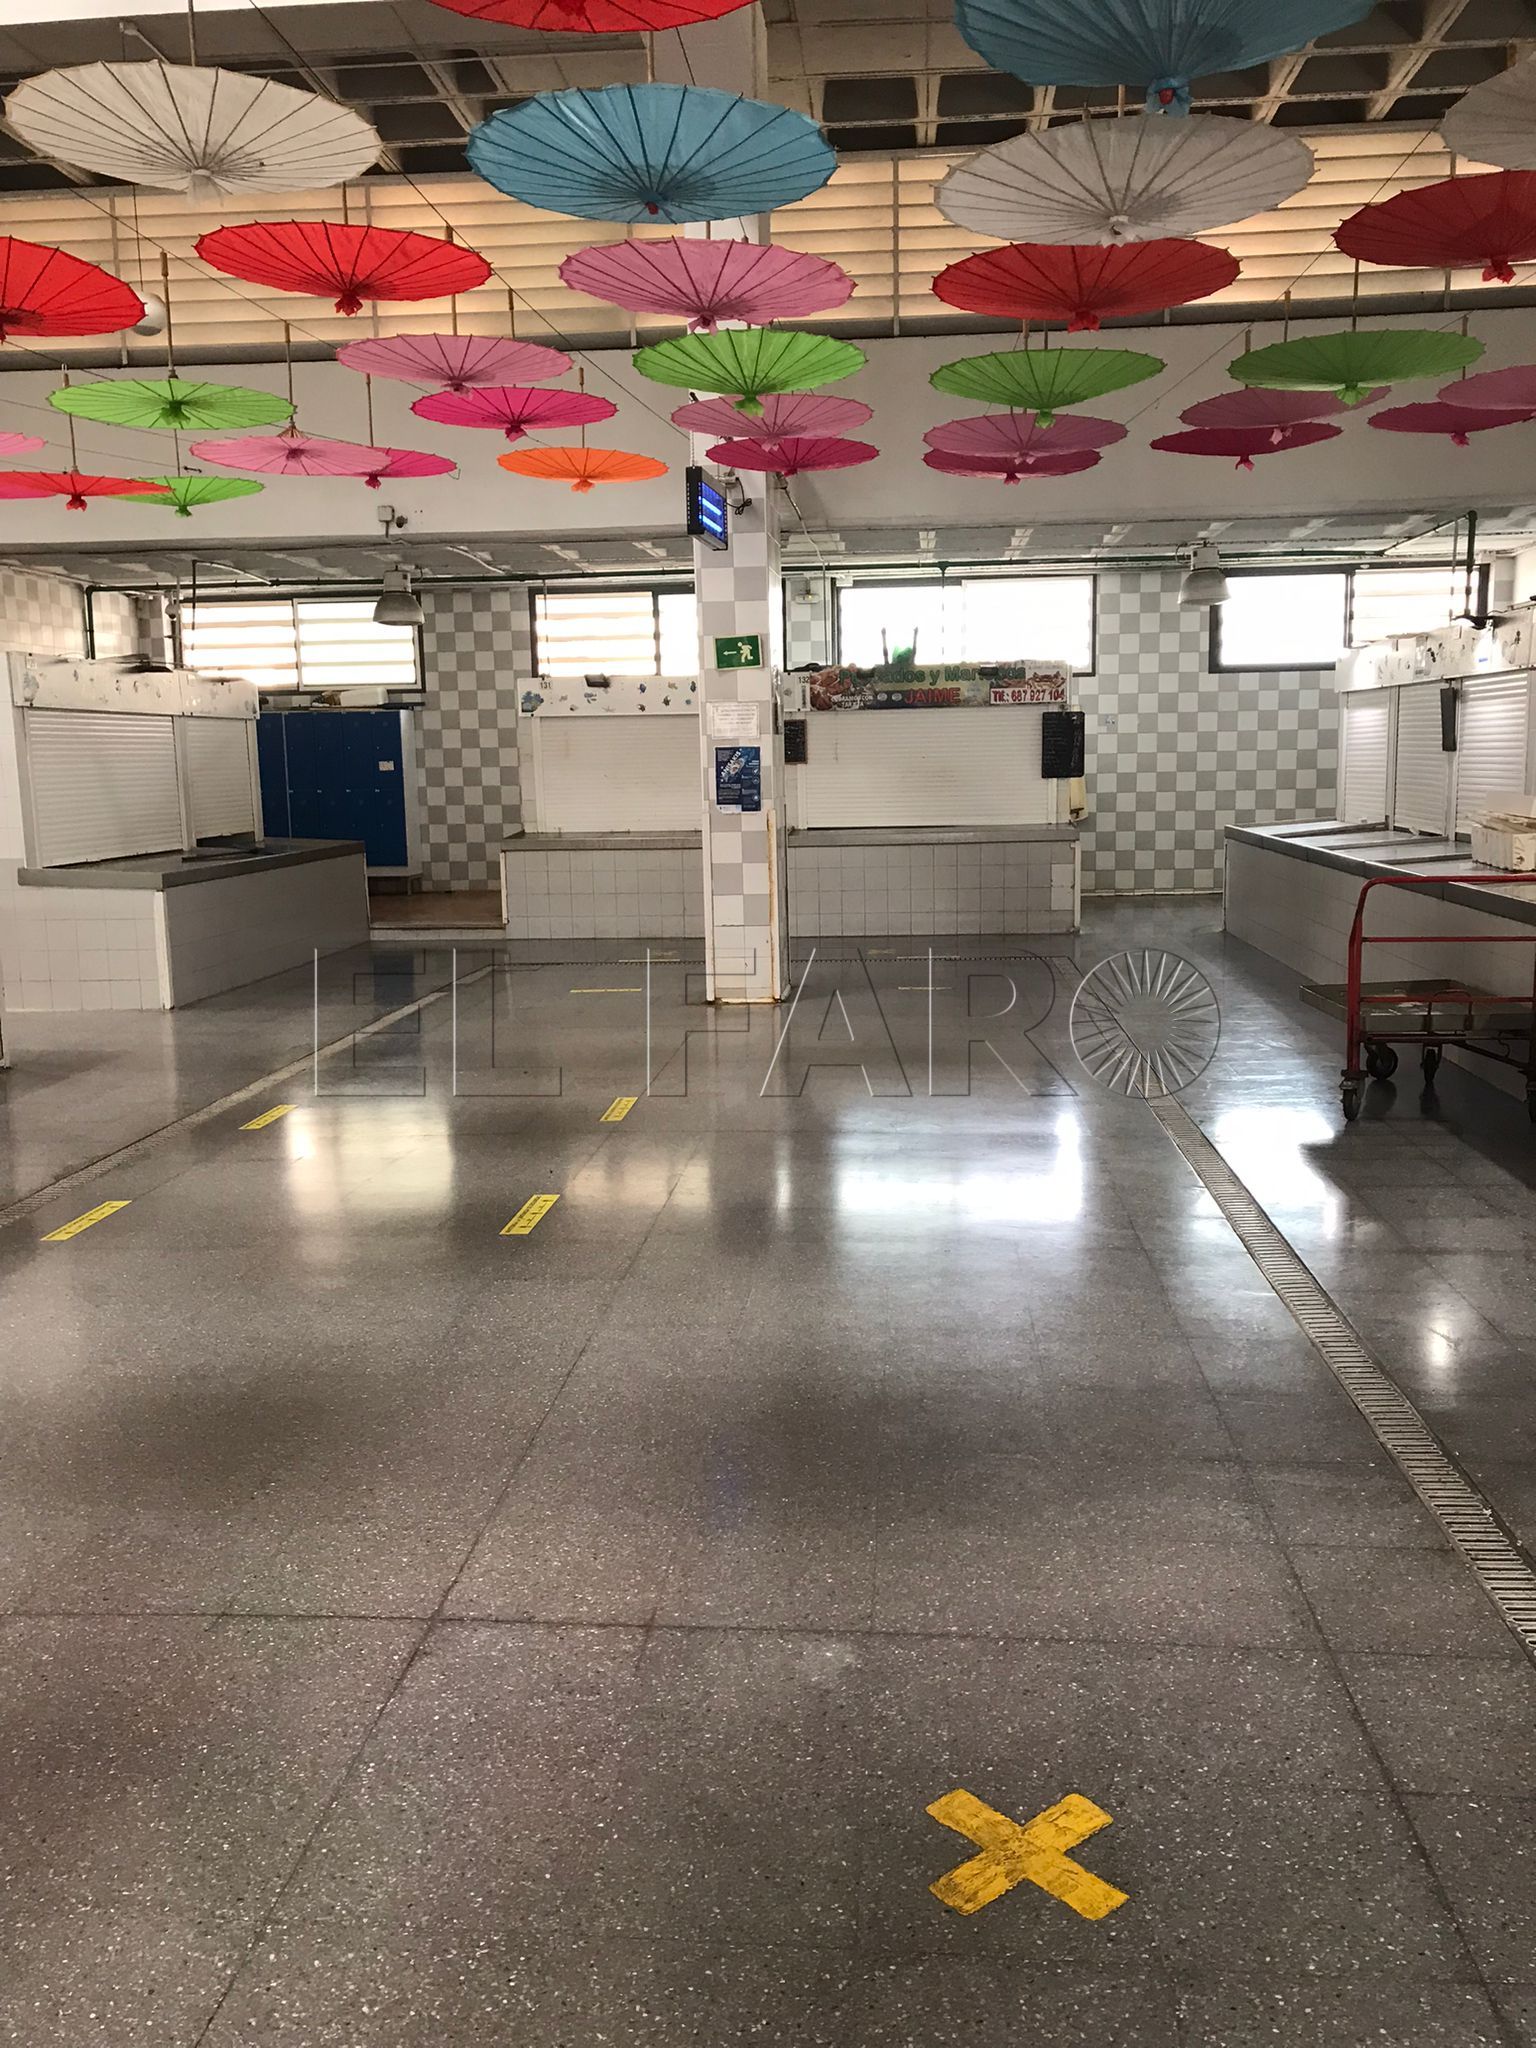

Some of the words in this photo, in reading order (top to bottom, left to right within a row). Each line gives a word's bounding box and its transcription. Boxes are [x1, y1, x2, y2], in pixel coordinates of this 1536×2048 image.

[798, 676, 810, 684] 132
[929, 669, 940, 686] y
[540, 681, 552, 689] 131
[905, 687, 961, 704] JAIME
[1010, 690, 1028, 702] 687
[1030, 689, 1047, 701] 927
[1048, 688, 1066, 701] 104
